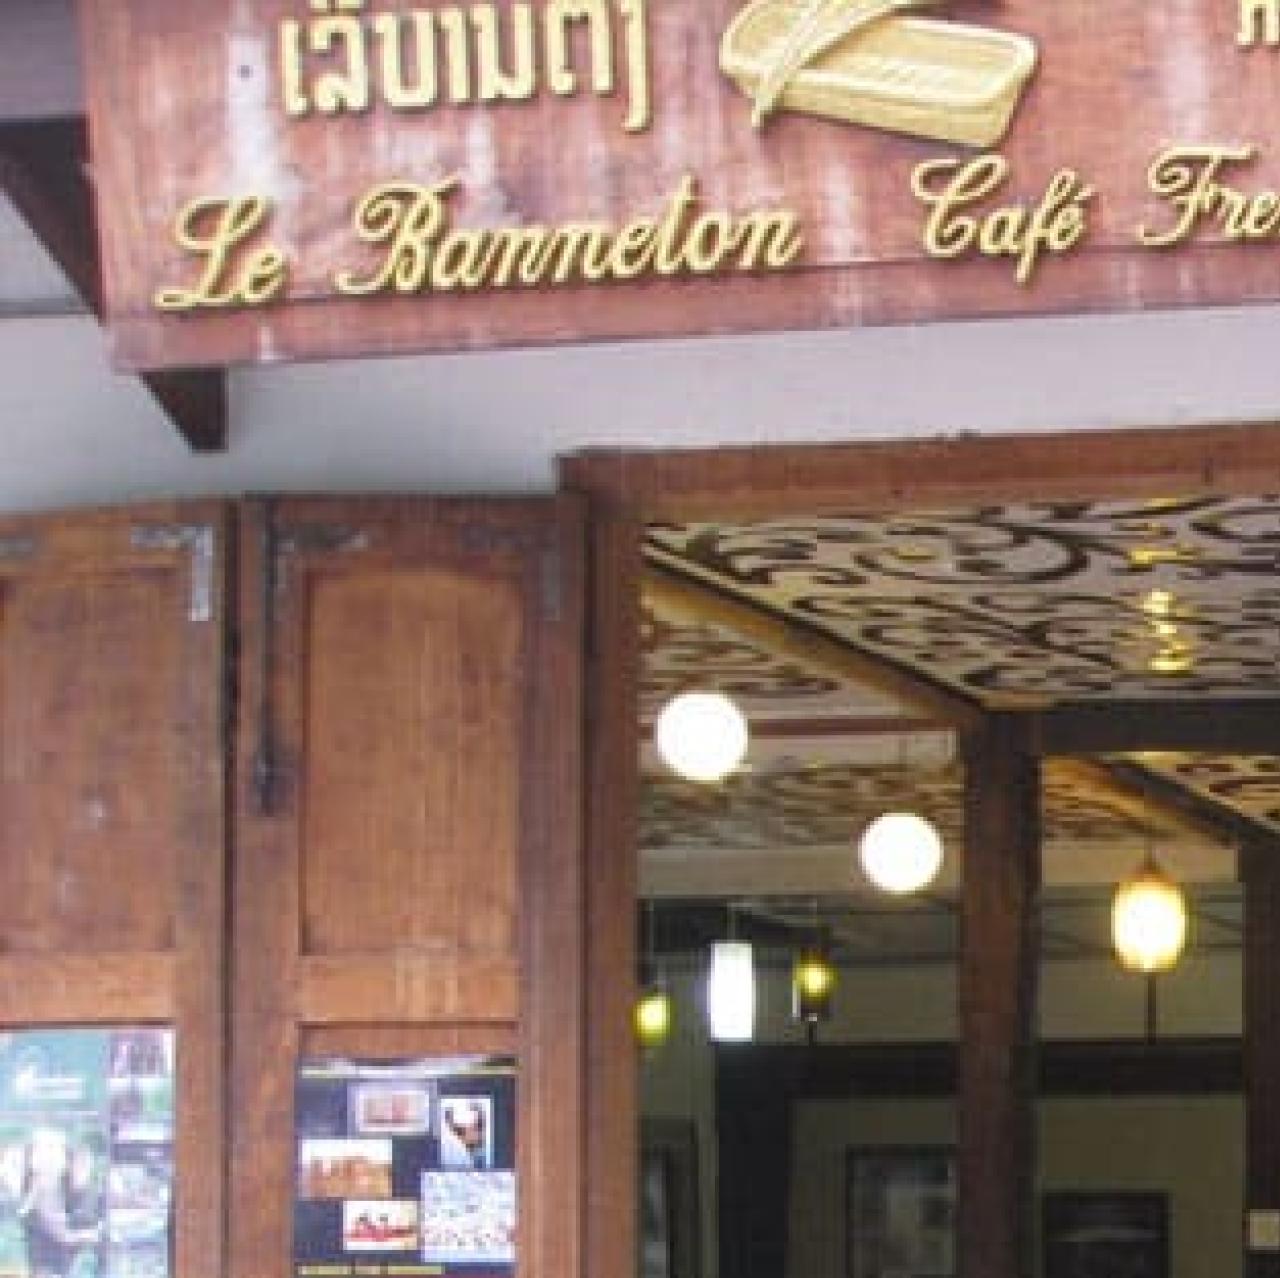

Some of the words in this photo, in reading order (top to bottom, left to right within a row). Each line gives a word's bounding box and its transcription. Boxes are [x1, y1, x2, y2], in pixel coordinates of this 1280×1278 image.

[155, 192, 286, 310] Le
[334, 176, 802, 295] Banneton
[910, 153, 1094, 283] Café
